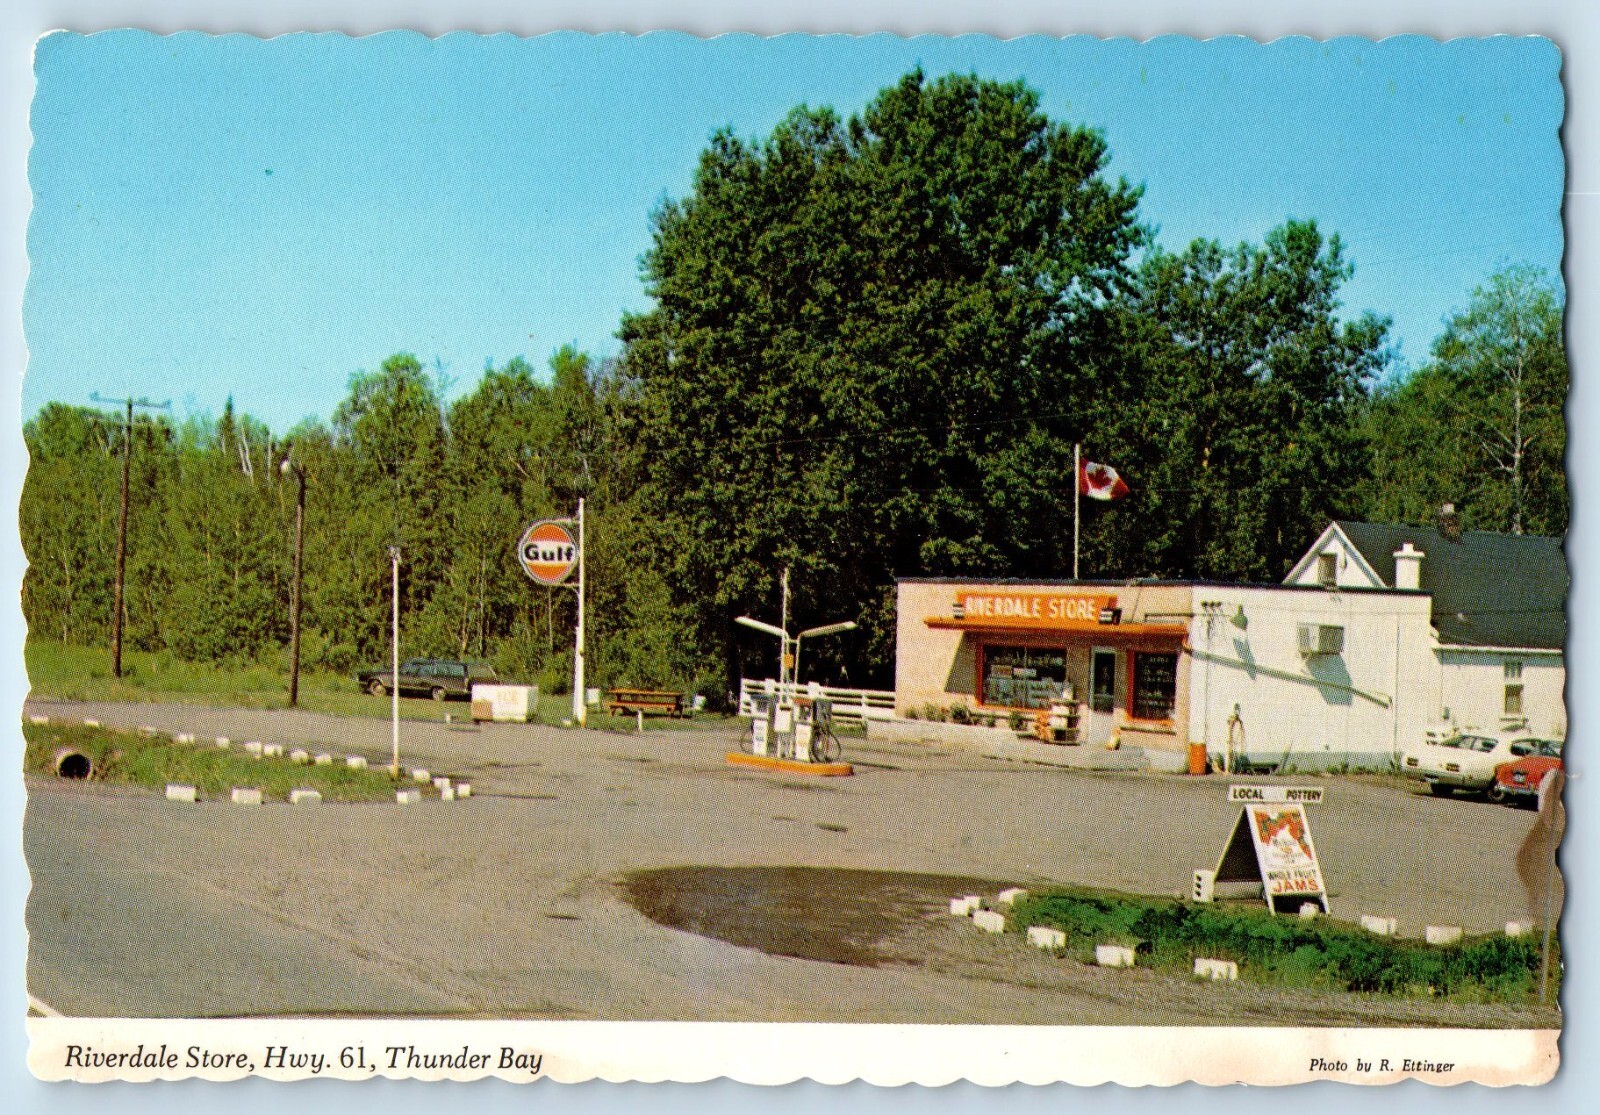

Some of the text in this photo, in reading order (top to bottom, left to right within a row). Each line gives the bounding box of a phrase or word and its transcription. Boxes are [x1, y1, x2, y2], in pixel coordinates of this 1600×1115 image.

[524, 543, 573, 561] Gulf
[1048, 599, 1097, 621] STORE
[1233, 787, 1321, 800] LOCAL POTTERY
[1273, 880, 1319, 892] JAMS
